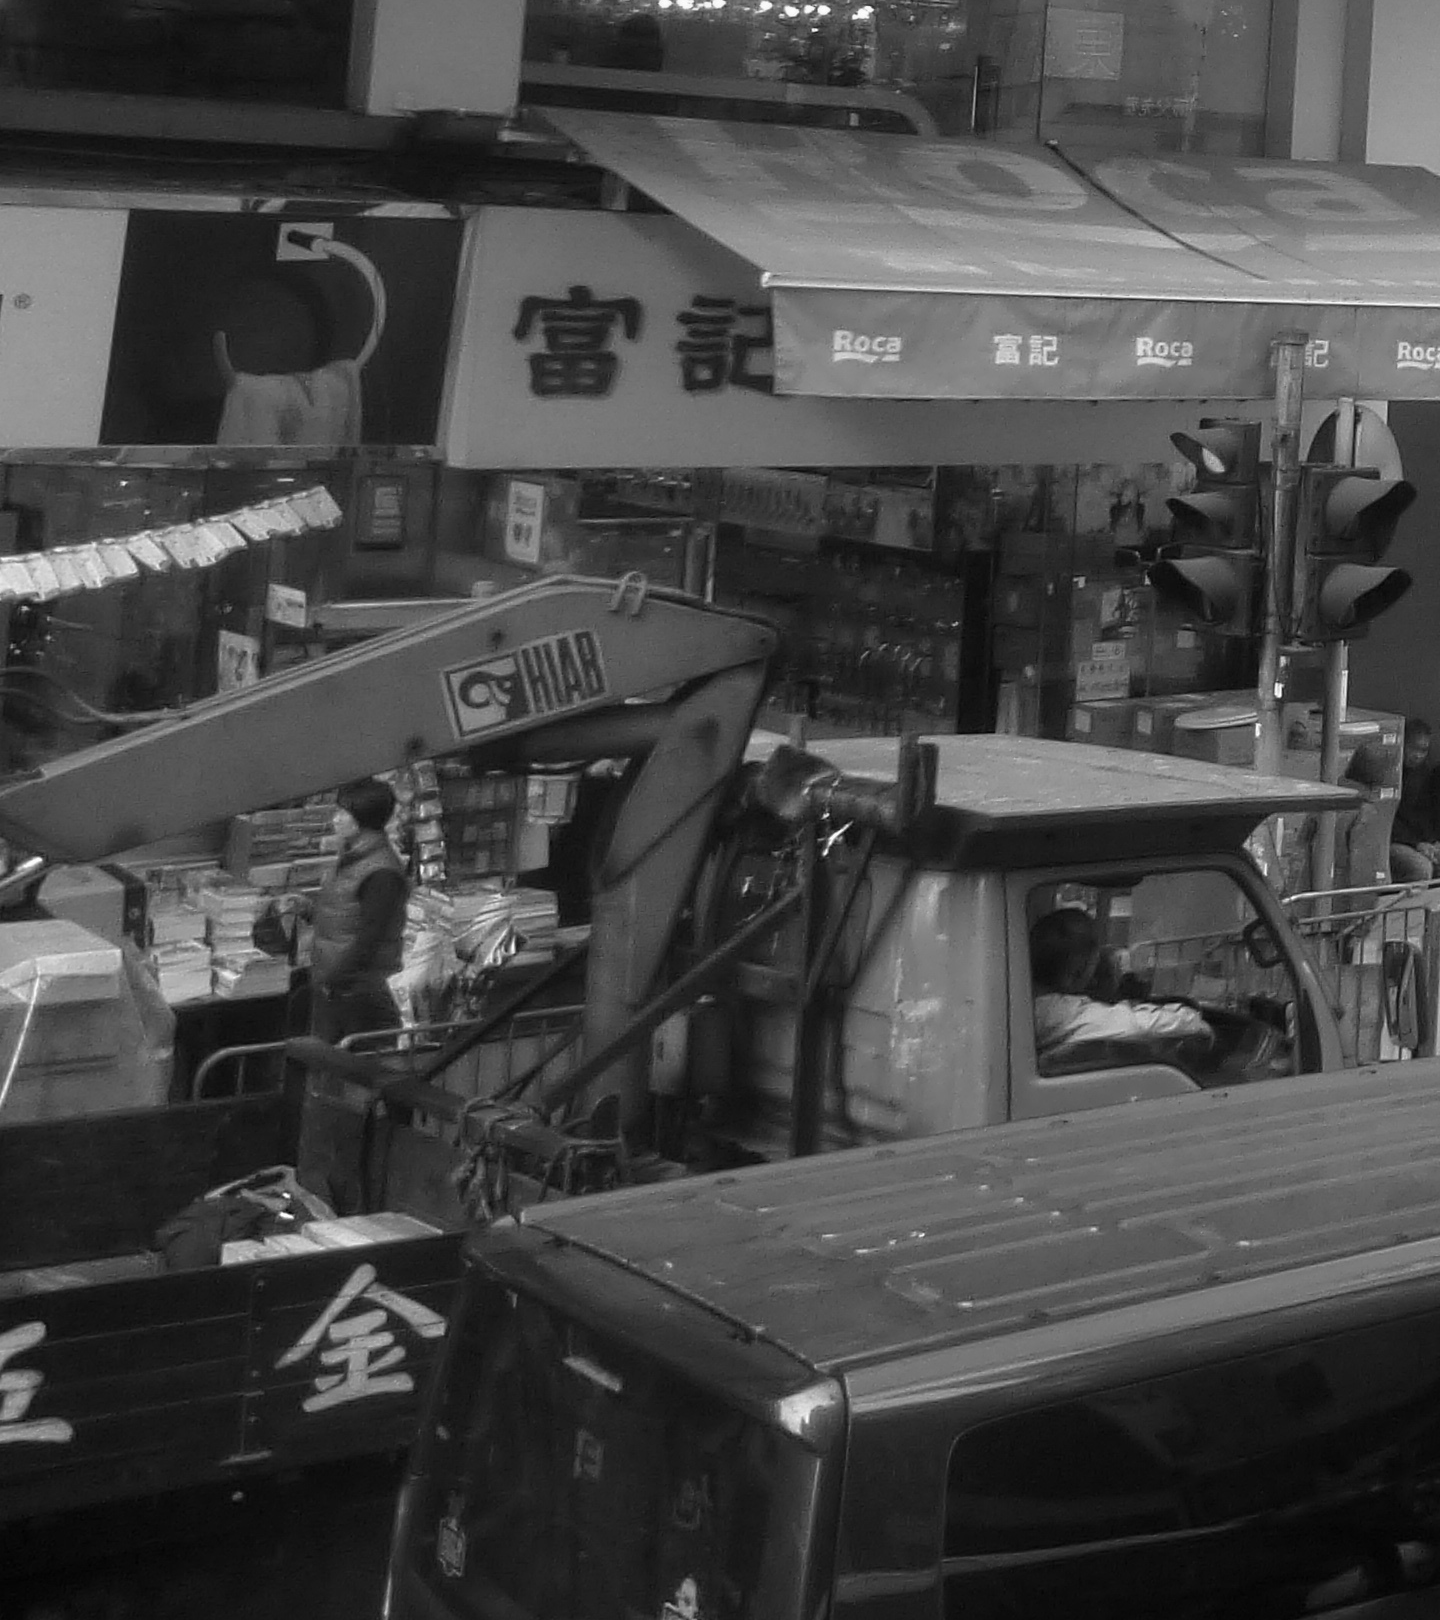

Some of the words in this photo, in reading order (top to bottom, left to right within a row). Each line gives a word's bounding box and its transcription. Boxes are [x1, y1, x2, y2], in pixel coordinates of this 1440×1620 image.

[512, 286, 773, 398] 富記
[832, 330, 902, 353] Roca
[994, 333, 1060, 367] 富記
[1136, 336, 1194, 358] Roca
[520, 630, 606, 716] HIAB
